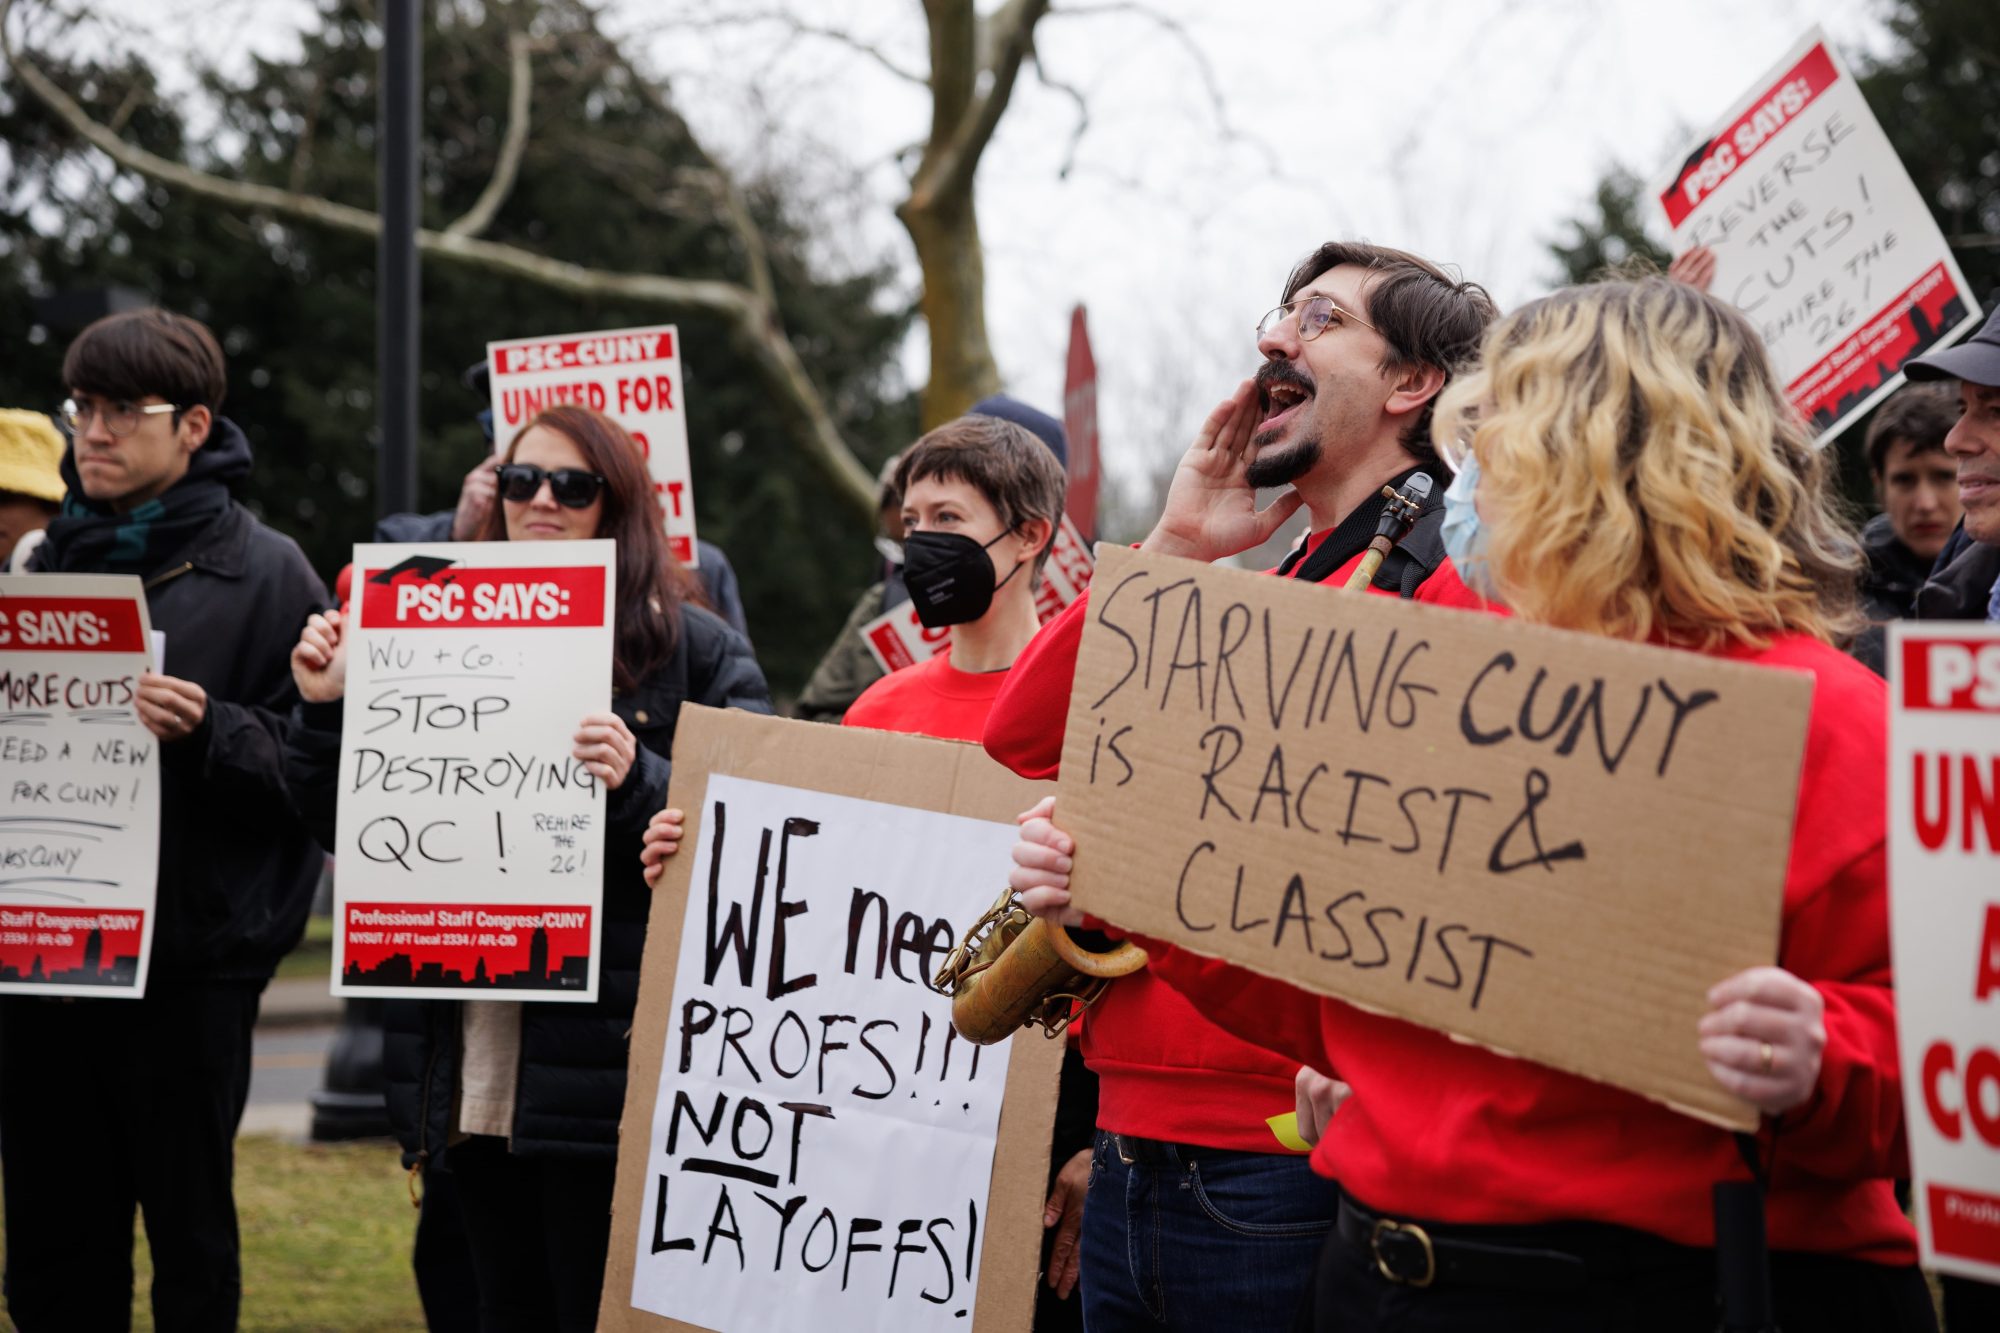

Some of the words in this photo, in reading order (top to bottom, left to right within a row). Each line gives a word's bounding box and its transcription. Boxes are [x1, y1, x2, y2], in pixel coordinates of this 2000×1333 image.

[1683, 142, 1738, 206] PSC
[1734, 76, 1813, 157] SAYS:
[1687, 111, 1857, 247] REVERSE
[1732, 173, 1874, 312] CUTS!
[1747, 199, 1809, 247] THE
[1764, 279, 1835, 346] EHIRE
[1845, 229, 1899, 279] THE
[506, 335, 662, 372] PSC-CUNY
[617, 375, 674, 414] FOR
[396, 583, 465, 621] PSC
[472, 582, 571, 621] SAYS:
[16, 610, 110, 646] SAYS:
[1091, 571, 1439, 733] STARVING
[1459, 651, 1720, 778] CUNY
[363, 689, 510, 735] STOP
[0, 736, 47, 763] EED
[58, 741, 71, 761] A
[92, 739, 151, 767] NEW
[352, 749, 597, 799] DESTROYING
[11, 780, 52, 804] FOR
[1199, 724, 1491, 874] RACIST
[1488, 767, 1586, 873] &
[532, 813, 592, 832] REHIRE
[551, 835, 576, 848] THE
[350, 909, 435, 926] Professional
[438, 910, 474, 927] Staff
[476, 911, 586, 931] Congress/CUNY
[703, 800, 820, 1001] WE
[844, 887, 957, 995] nee
[349, 932, 384, 944] NYSUT
[392, 932, 412, 944] AFT
[414, 933, 441, 945] Local
[442, 933, 469, 946] 2334
[1176, 841, 1534, 1010] CLASSIST
[666, 1090, 836, 1185] NOT
[650, 1174, 979, 1318] LAYOFFS!
